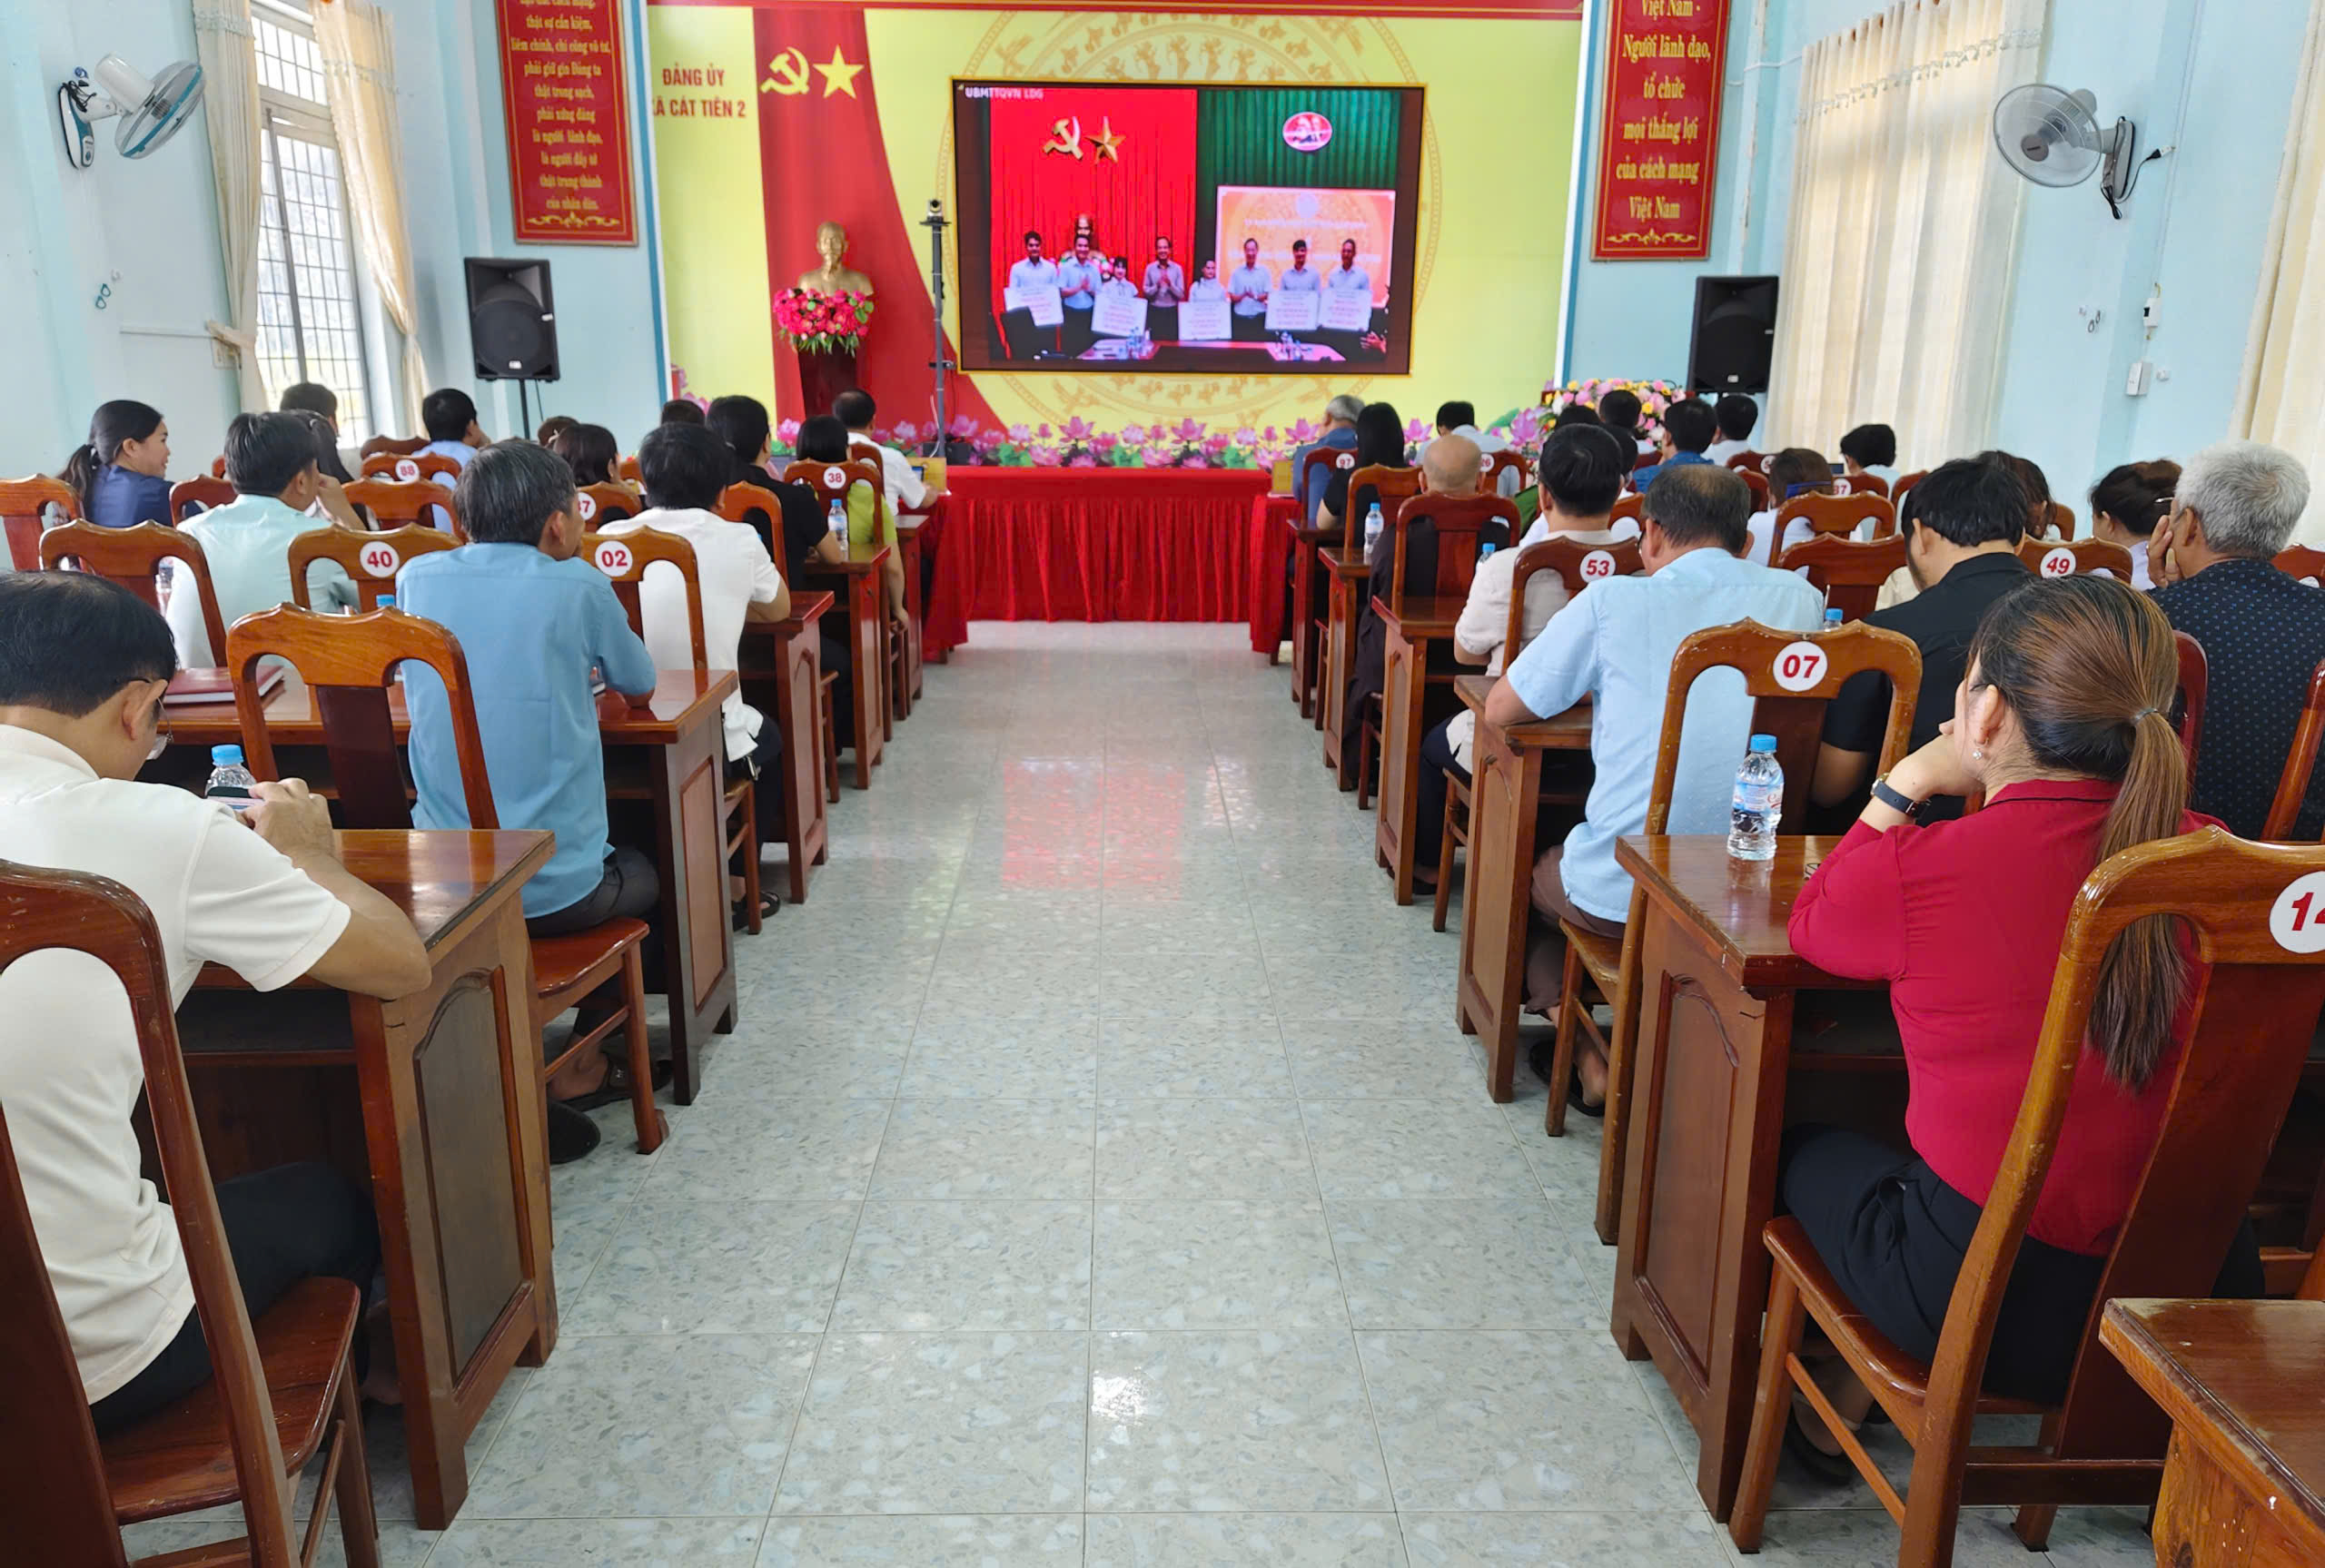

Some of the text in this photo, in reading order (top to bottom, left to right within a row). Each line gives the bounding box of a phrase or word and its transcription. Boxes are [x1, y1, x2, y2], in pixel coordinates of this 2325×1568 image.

[1622, 34, 1657, 64] Người
[1659, 34, 1685, 57] lãnh
[662, 62, 726, 86] ĐẢNG ỦY
[1643, 71, 1686, 99] tổ chức
[669, 96, 696, 117] CÁT
[737, 100, 747, 118] 2
[1623, 111, 1699, 145] mọi thắng lợi
[1616, 154, 1700, 185] của cách mạng
[1628, 195, 1680, 223] Việt Nam
[827, 472, 843, 484] 38
[366, 550, 393, 568] 40
[600, 549, 628, 567] 02
[1585, 558, 1610, 577] 53
[2045, 556, 2072, 575] 49
[1782, 654, 1820, 679] 07
